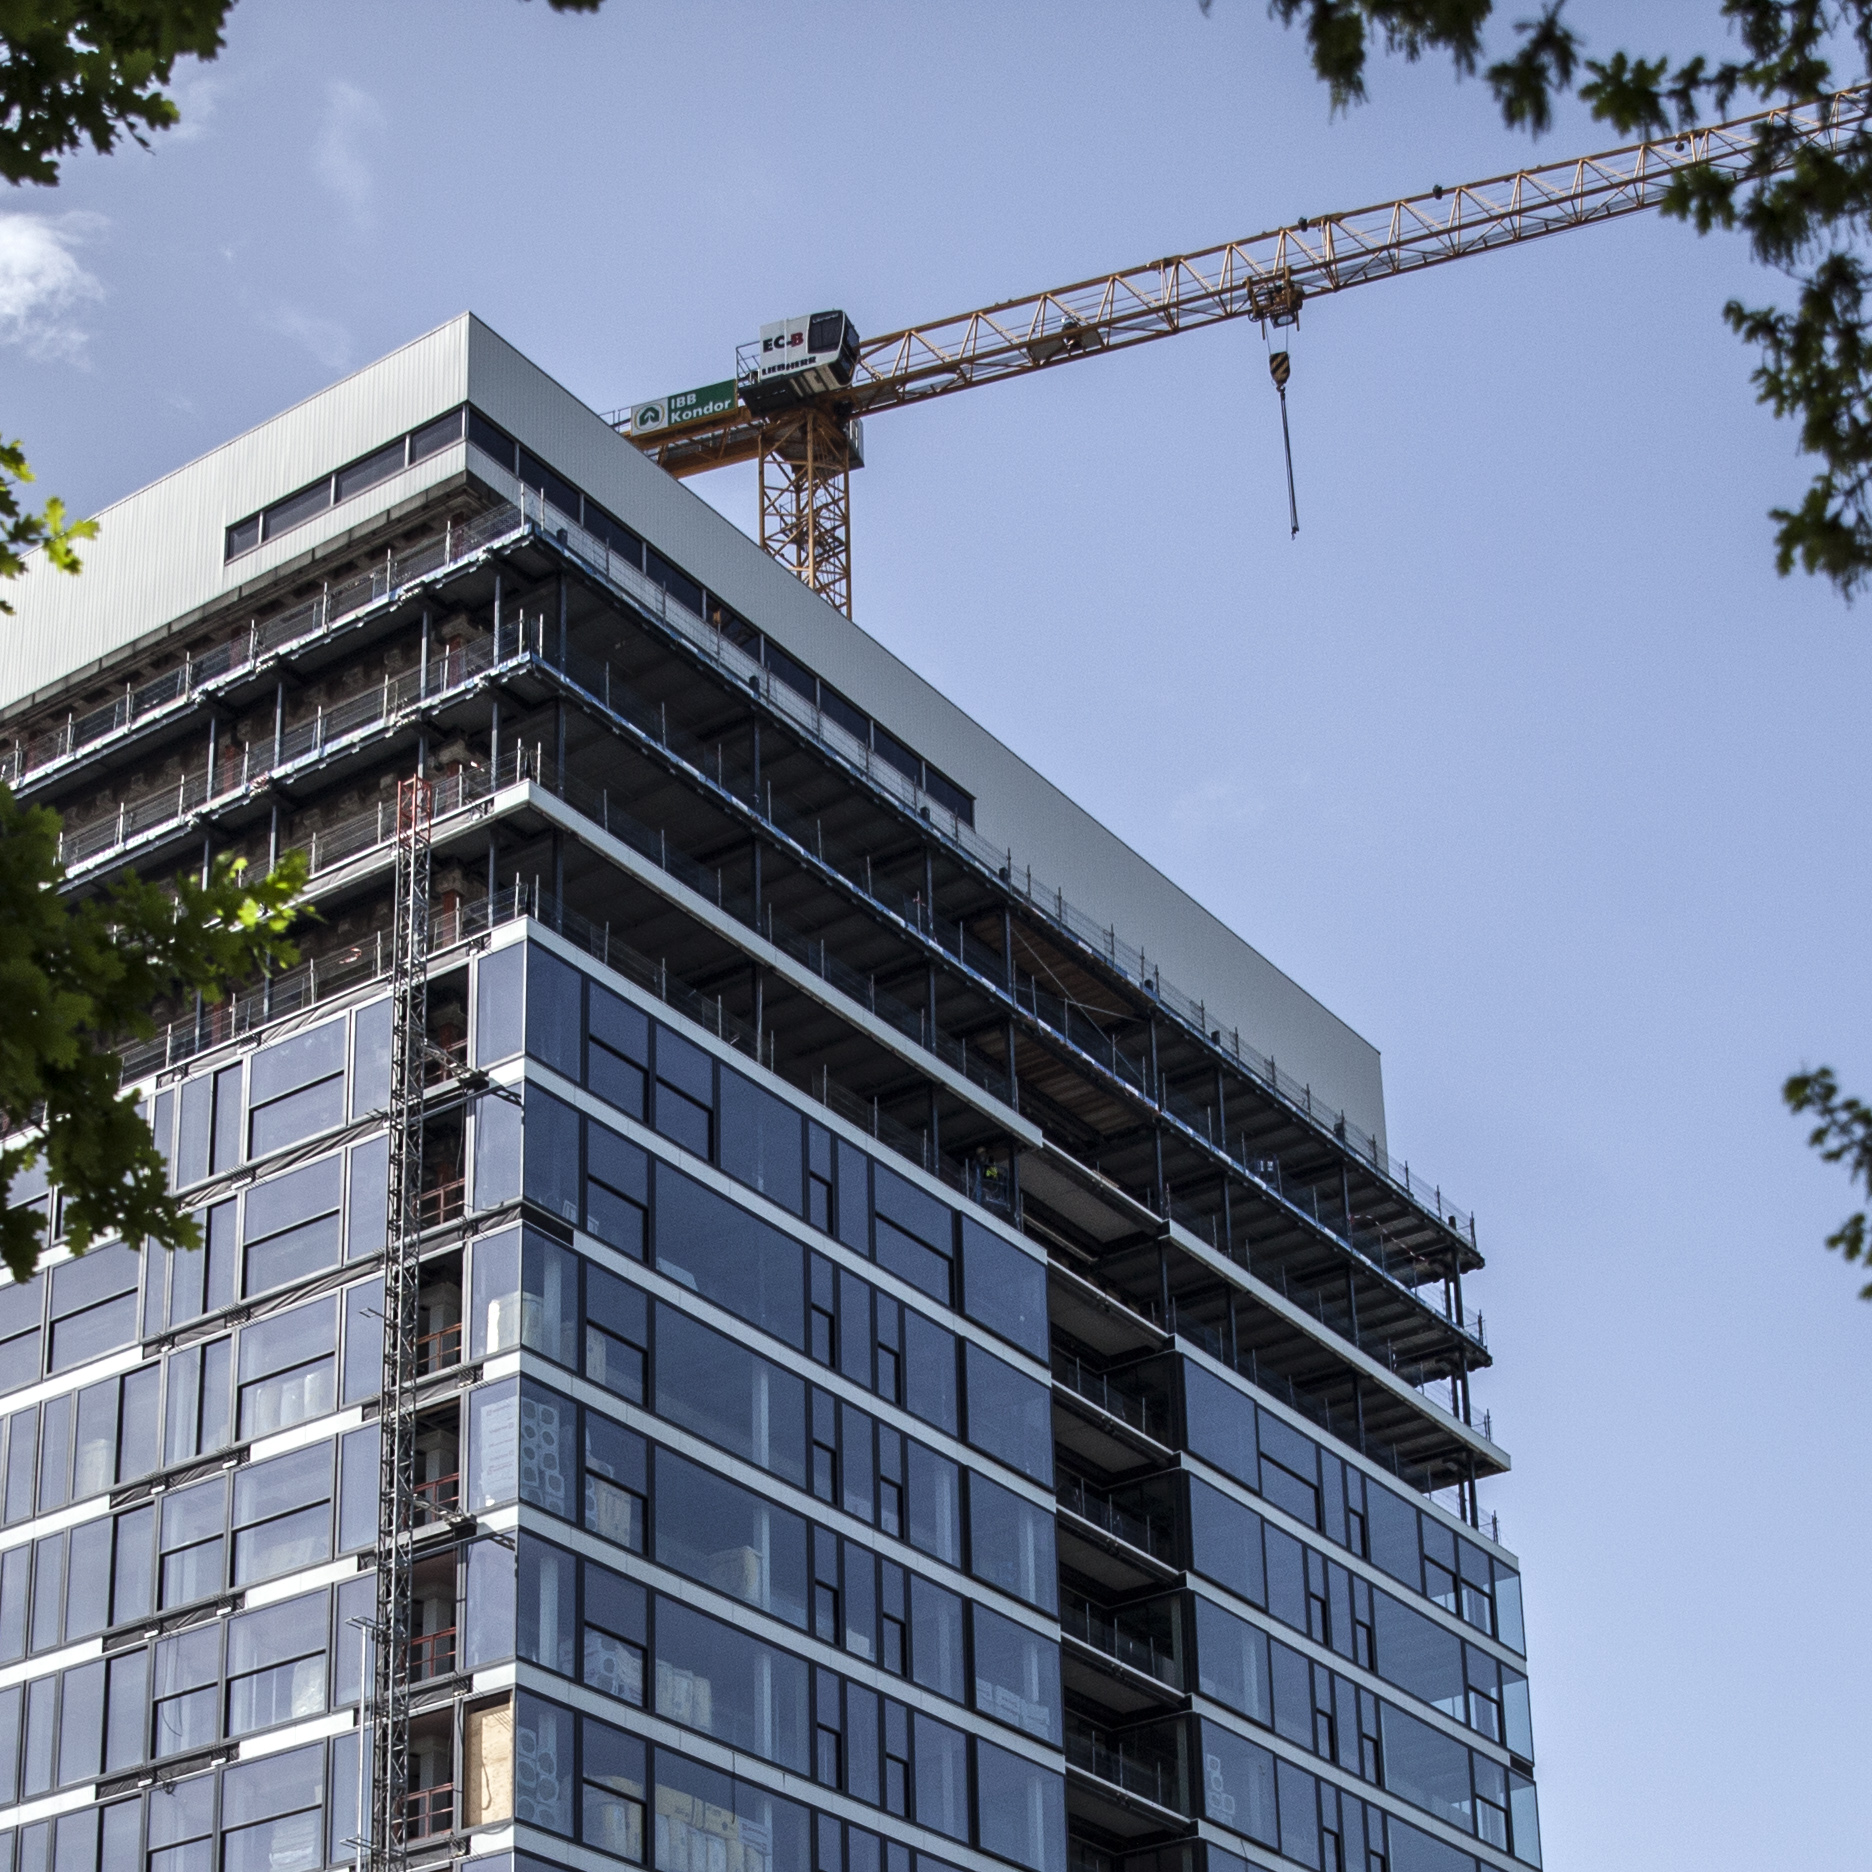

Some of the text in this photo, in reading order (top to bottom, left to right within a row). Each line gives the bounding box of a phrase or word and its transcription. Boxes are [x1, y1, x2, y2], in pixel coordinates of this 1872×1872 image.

[762, 332, 805, 353] EC-B
[761, 356, 817, 377] LIEBHERR
[670, 393, 698, 411] IBB
[671, 398, 732, 424] Kondor
